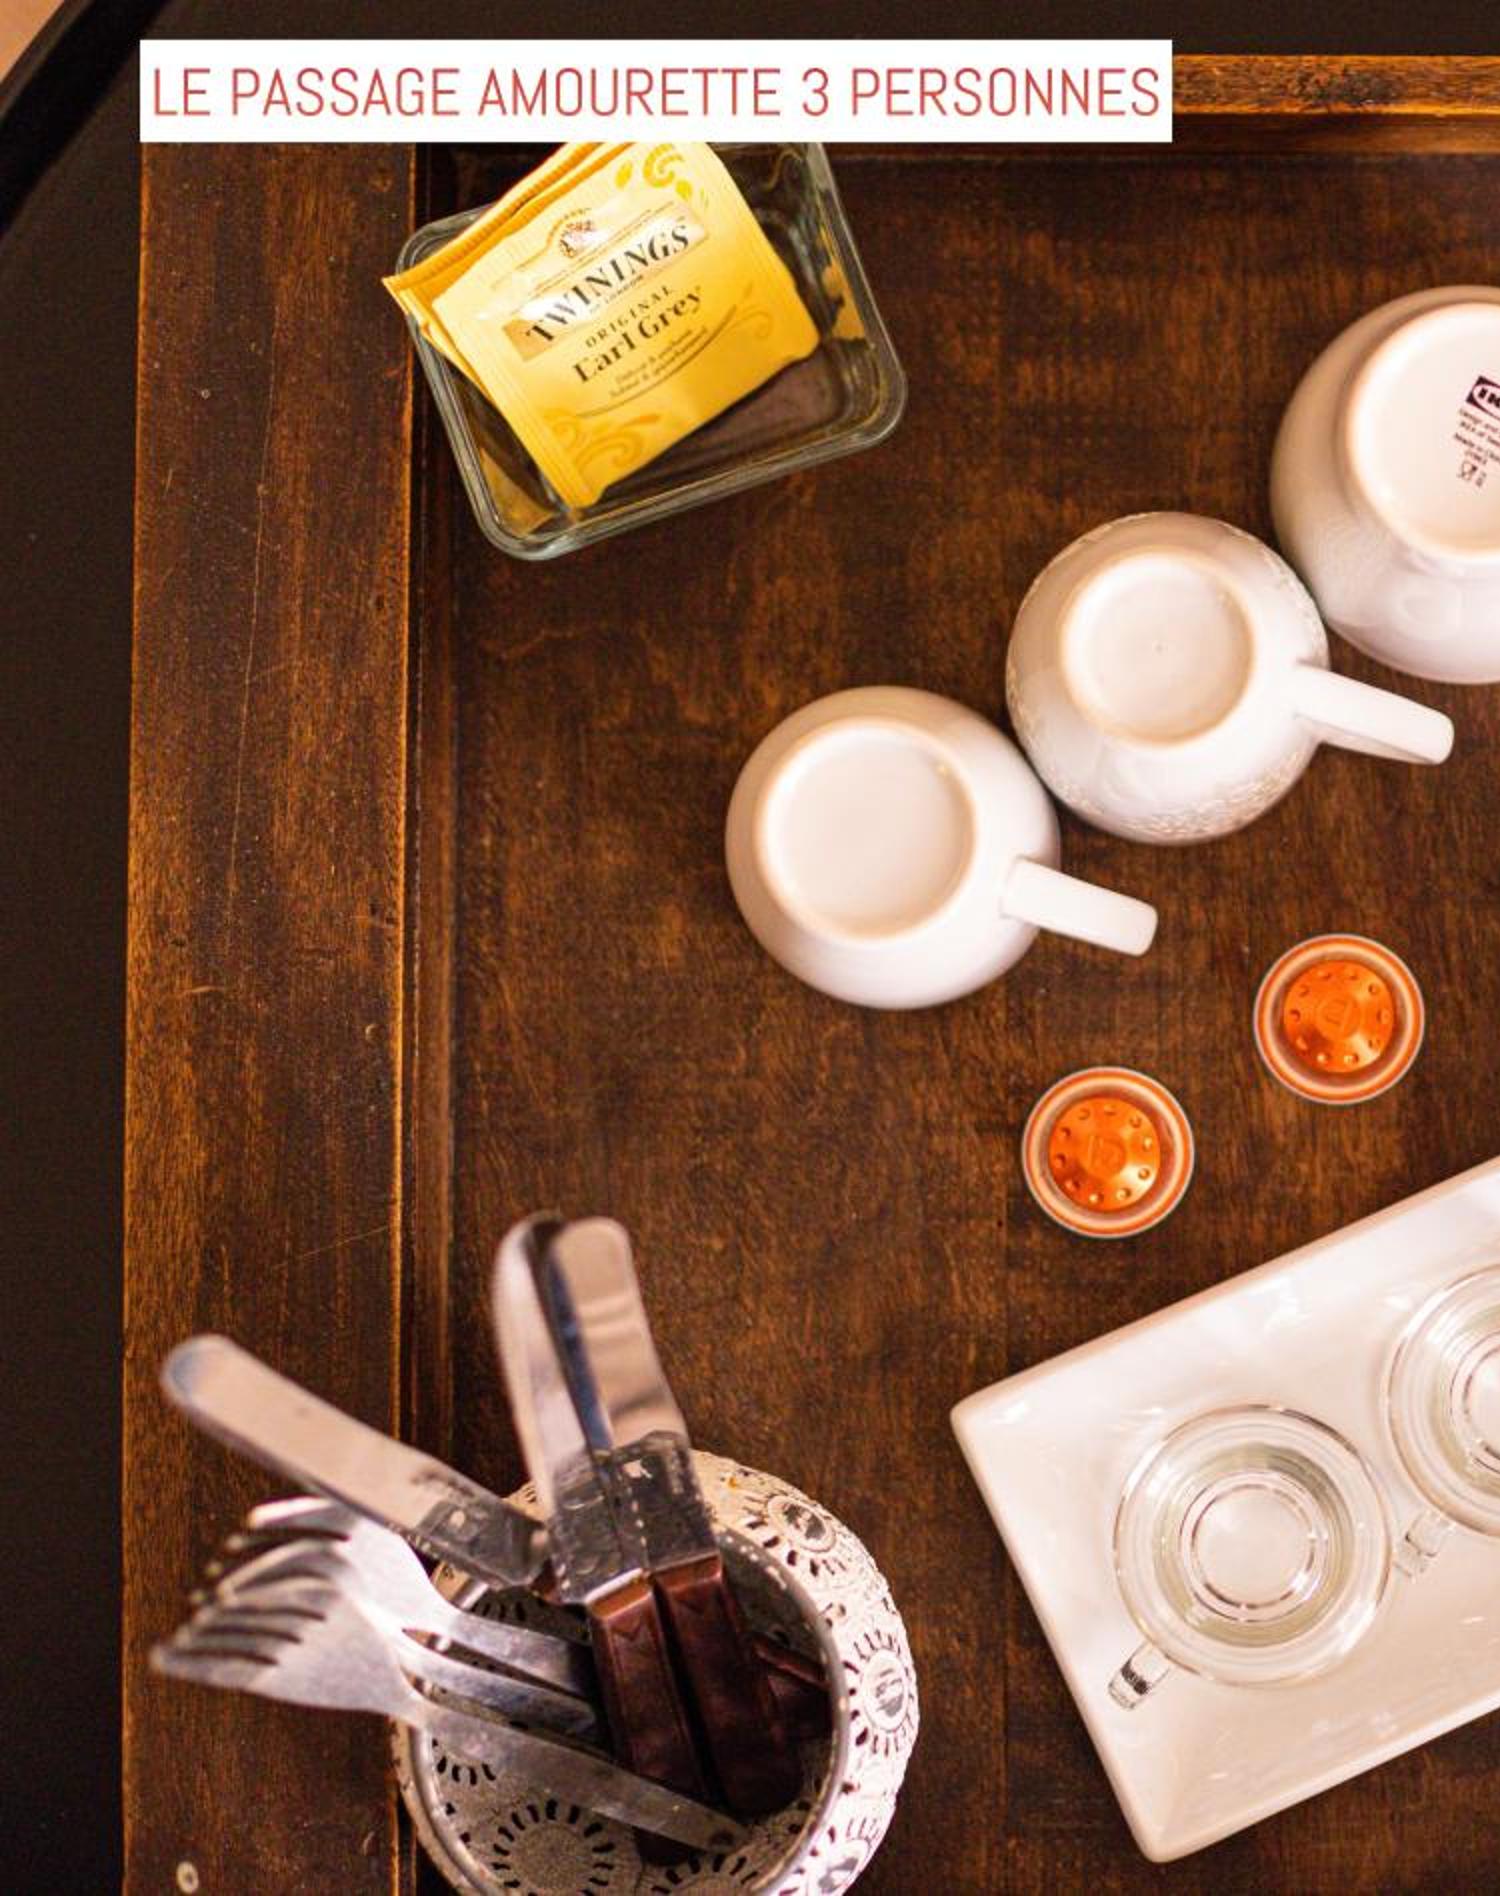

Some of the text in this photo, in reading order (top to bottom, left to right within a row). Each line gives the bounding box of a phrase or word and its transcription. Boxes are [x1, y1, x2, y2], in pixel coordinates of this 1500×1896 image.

[525, 224, 689, 342] TWININGS
[585, 285, 674, 349] ORIGINAL
[572, 332, 637, 383] Earl
[637, 290, 701, 340] Grey
